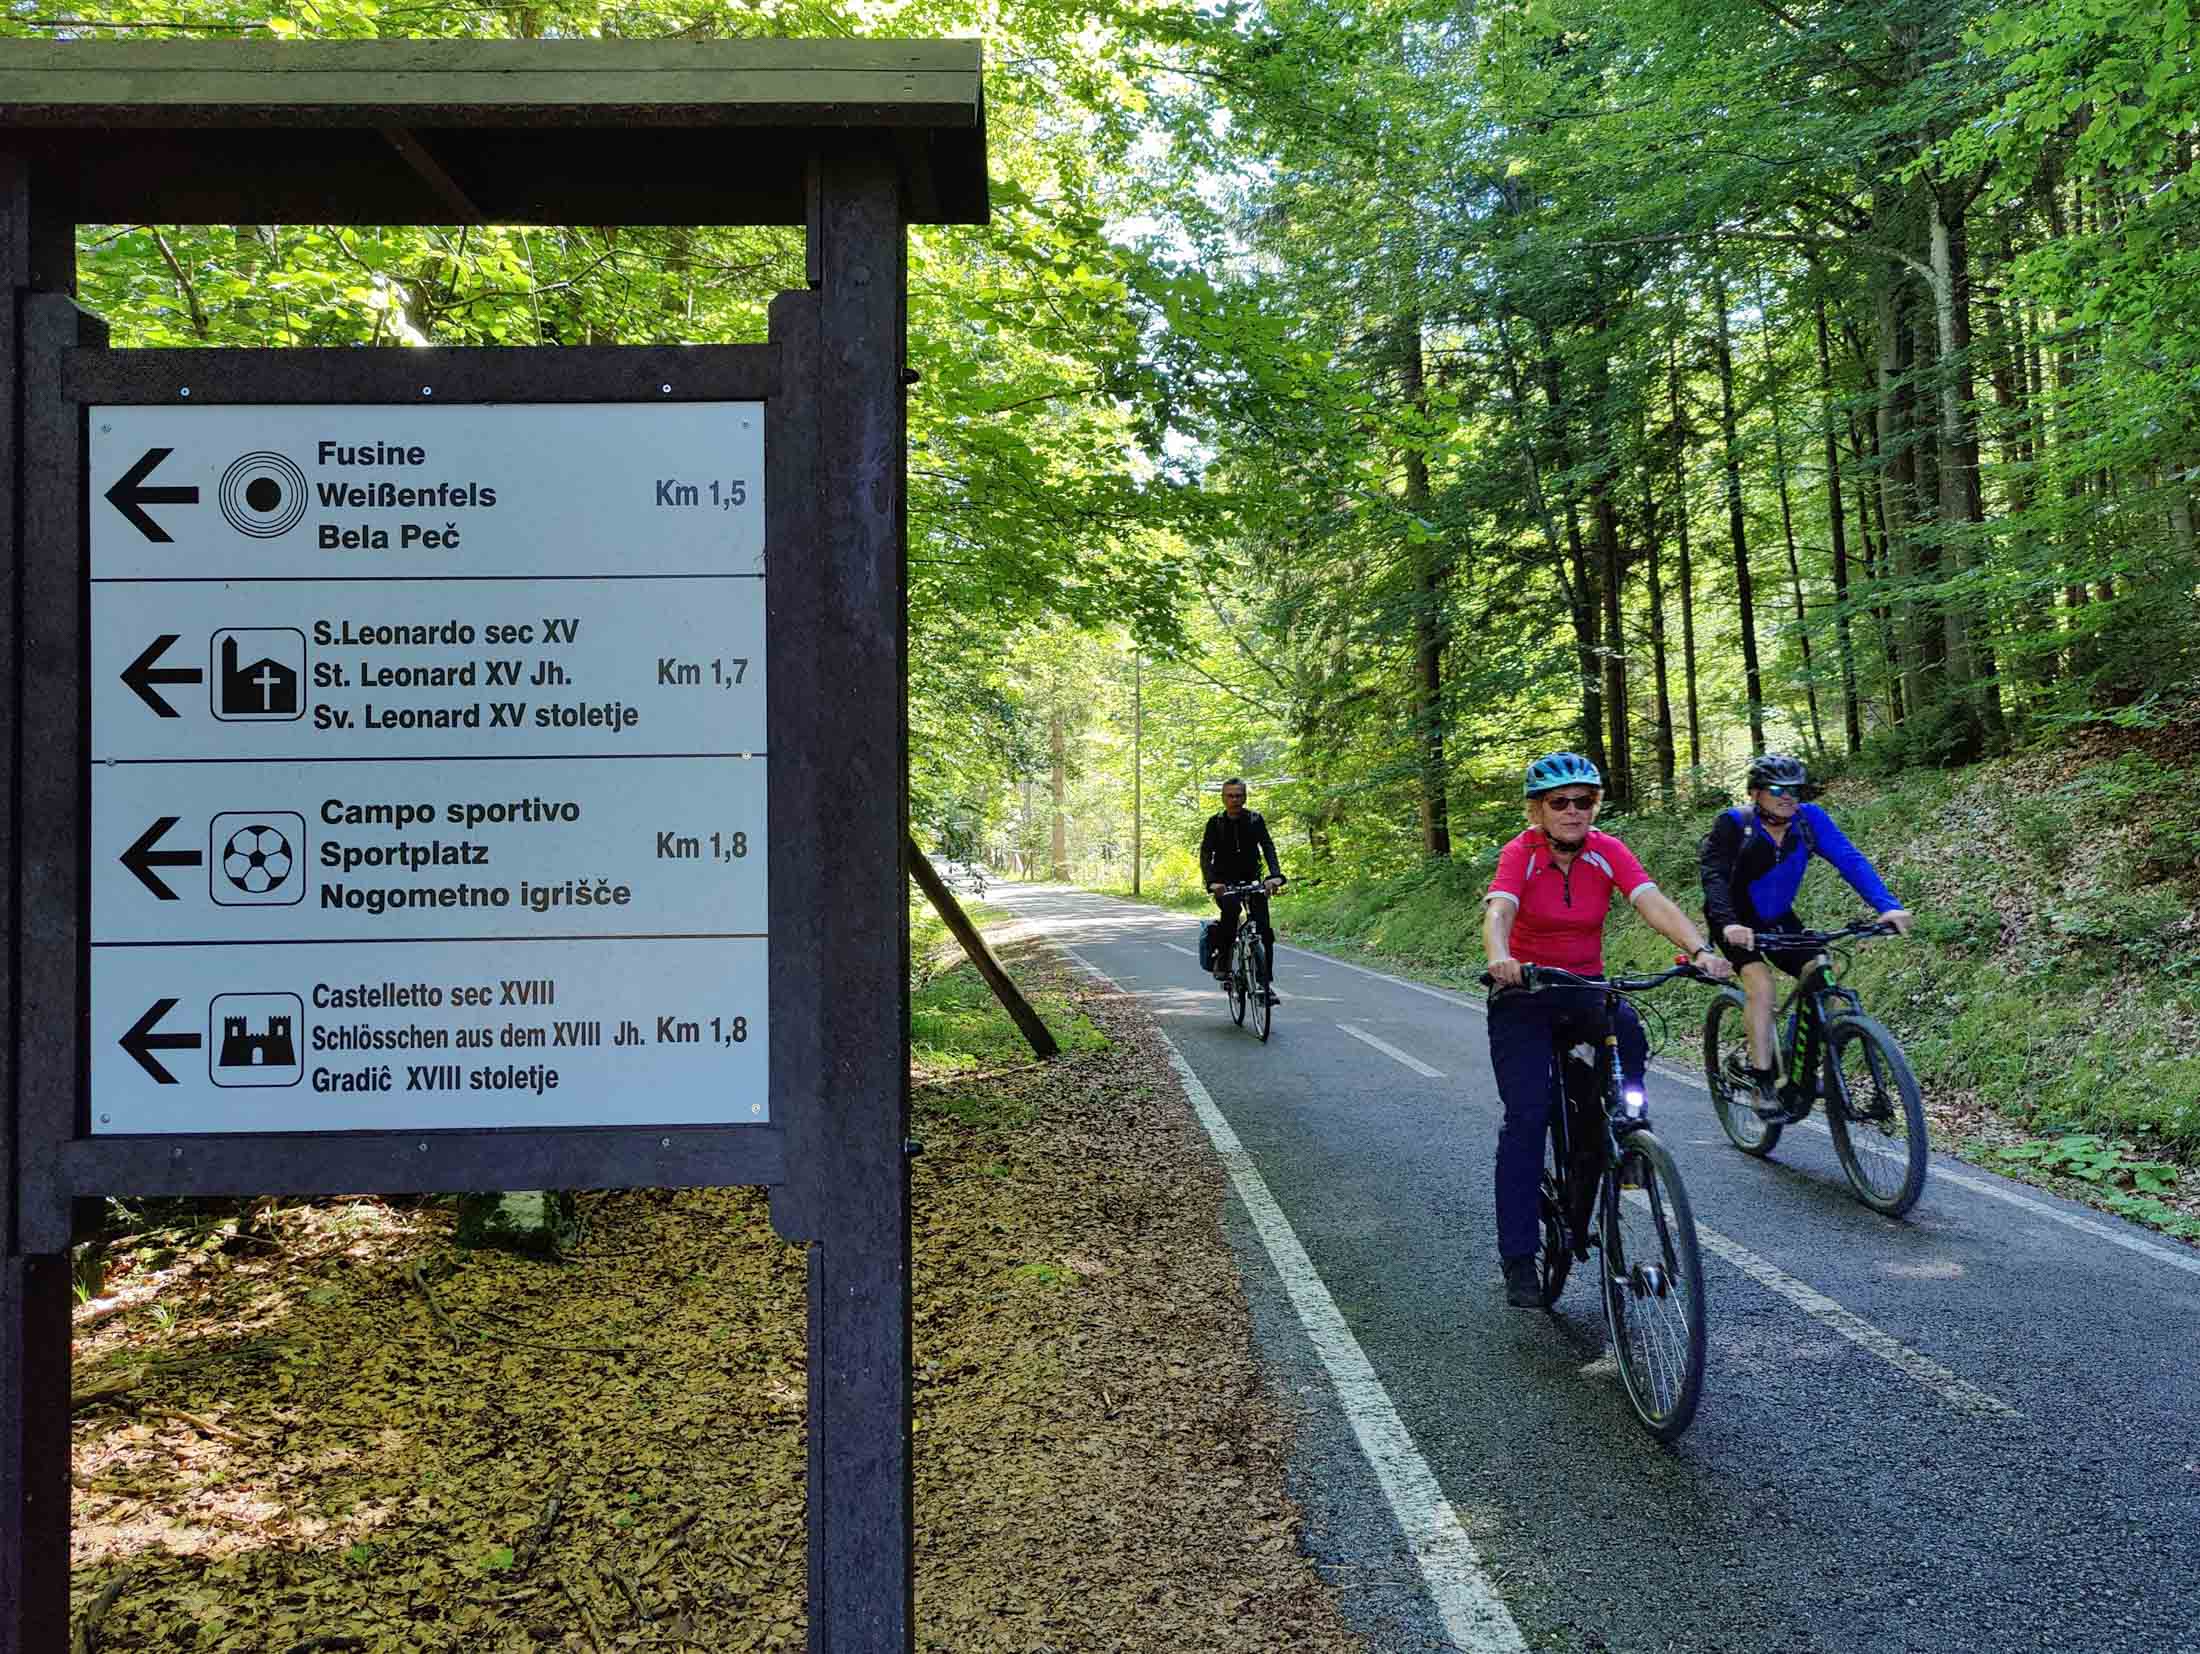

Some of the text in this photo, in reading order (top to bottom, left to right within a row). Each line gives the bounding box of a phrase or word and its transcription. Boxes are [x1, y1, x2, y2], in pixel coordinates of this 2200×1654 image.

[317, 440, 426, 466] Fusine
[316, 481, 497, 508] Weißenfels
[655, 479, 746, 512] Km 1,5
[318, 521, 461, 550] Bela Peč
[313, 618, 580, 646] S.Leonardo sec XV
[313, 660, 572, 688] St. Leonard XV Jh.
[657, 657, 748, 691] Km 1,7
[313, 701, 639, 734] Sv. Leonard XV stoletje
[320, 796, 580, 831] Campo sportivo
[320, 840, 489, 873] Sportplatz
[656, 831, 748, 864] Km 1,8
[320, 877, 632, 915] Nogometno igrišče
[312, 979, 555, 1009] Castelletto sec XVIII
[311, 1020, 646, 1051] Schlösschen aus dem XVIII Jh.
[656, 1015, 748, 1049] Km 1,8
[405, 1065, 461, 1092] XVIII
[469, 1064, 560, 1096] stoletje
